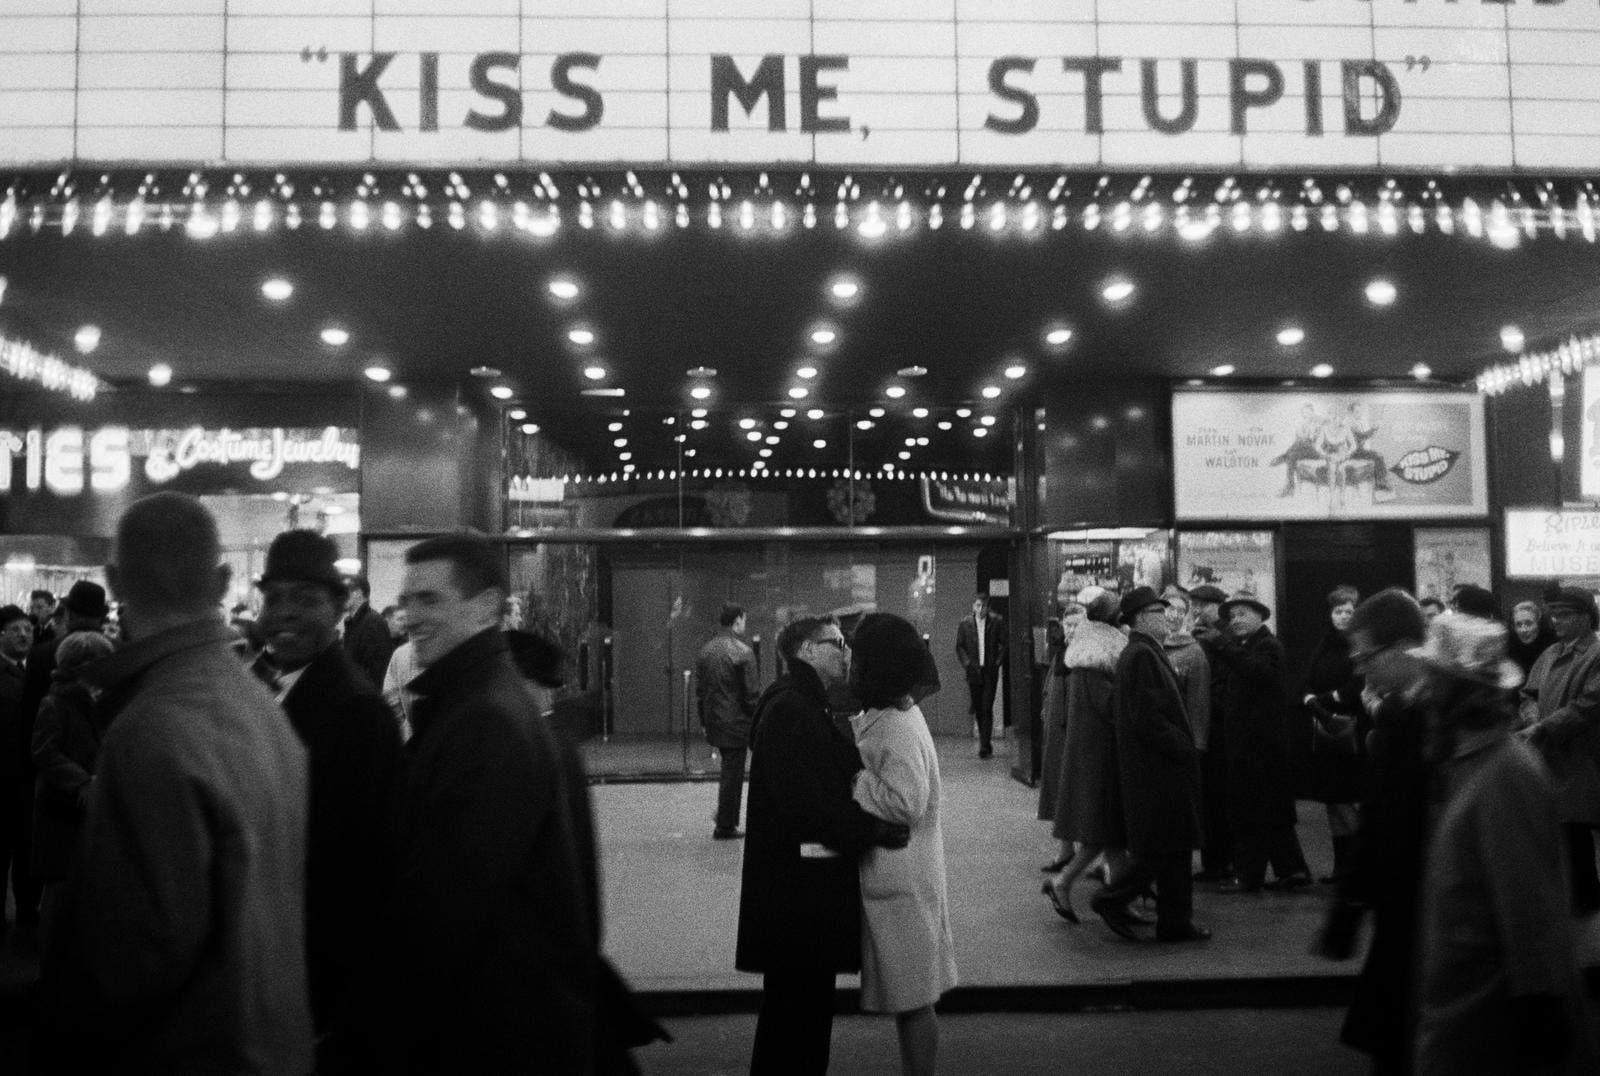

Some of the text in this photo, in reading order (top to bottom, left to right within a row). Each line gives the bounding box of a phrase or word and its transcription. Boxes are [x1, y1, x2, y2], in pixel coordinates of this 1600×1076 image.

[710, 53, 871, 141] ME,
[176, 427, 273, 468] Costume
[251, 426, 360, 480] Jewelry
[1186, 433, 1276, 447] MARTIN NOVAK
[1205, 455, 1259, 469] WALSTON
